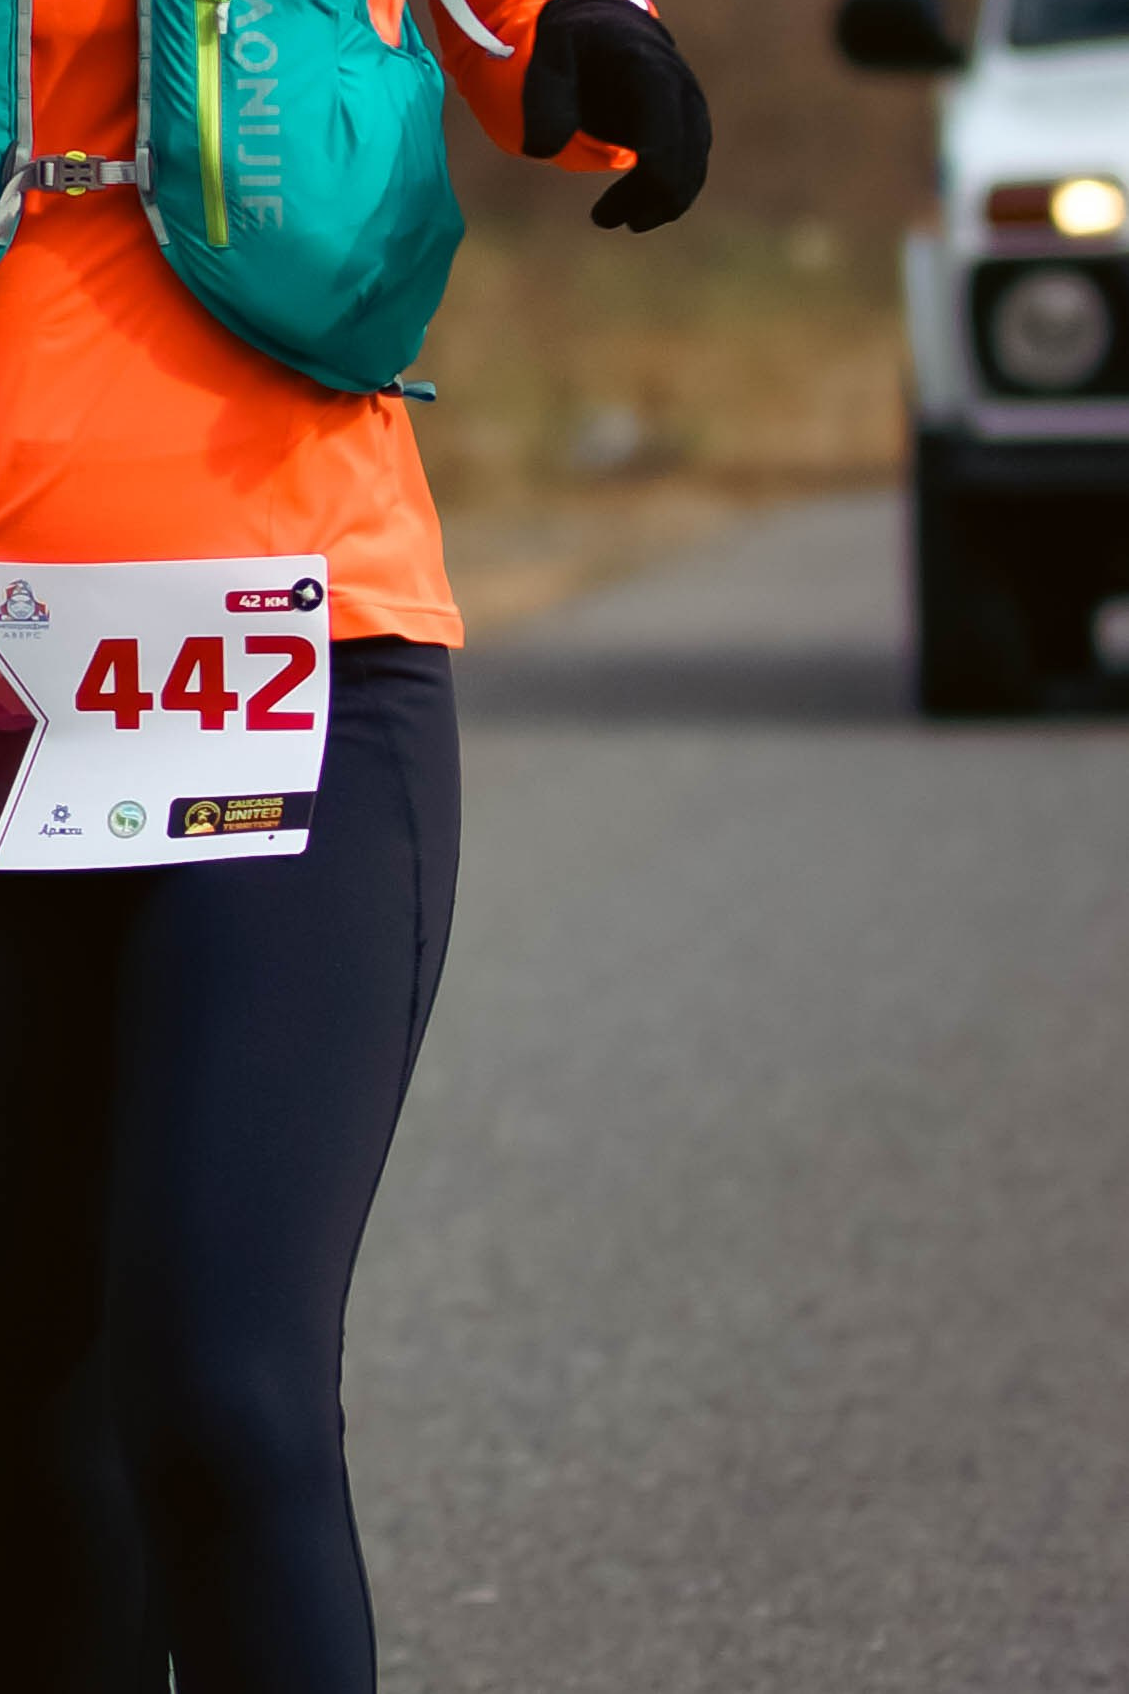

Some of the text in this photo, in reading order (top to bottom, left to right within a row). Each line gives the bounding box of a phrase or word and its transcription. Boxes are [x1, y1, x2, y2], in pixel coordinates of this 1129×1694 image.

[239, 594, 261, 608] 42
[75, 635, 317, 731] 442
[227, 797, 284, 809] CAUCASUS
[224, 807, 283, 822] UNITED
